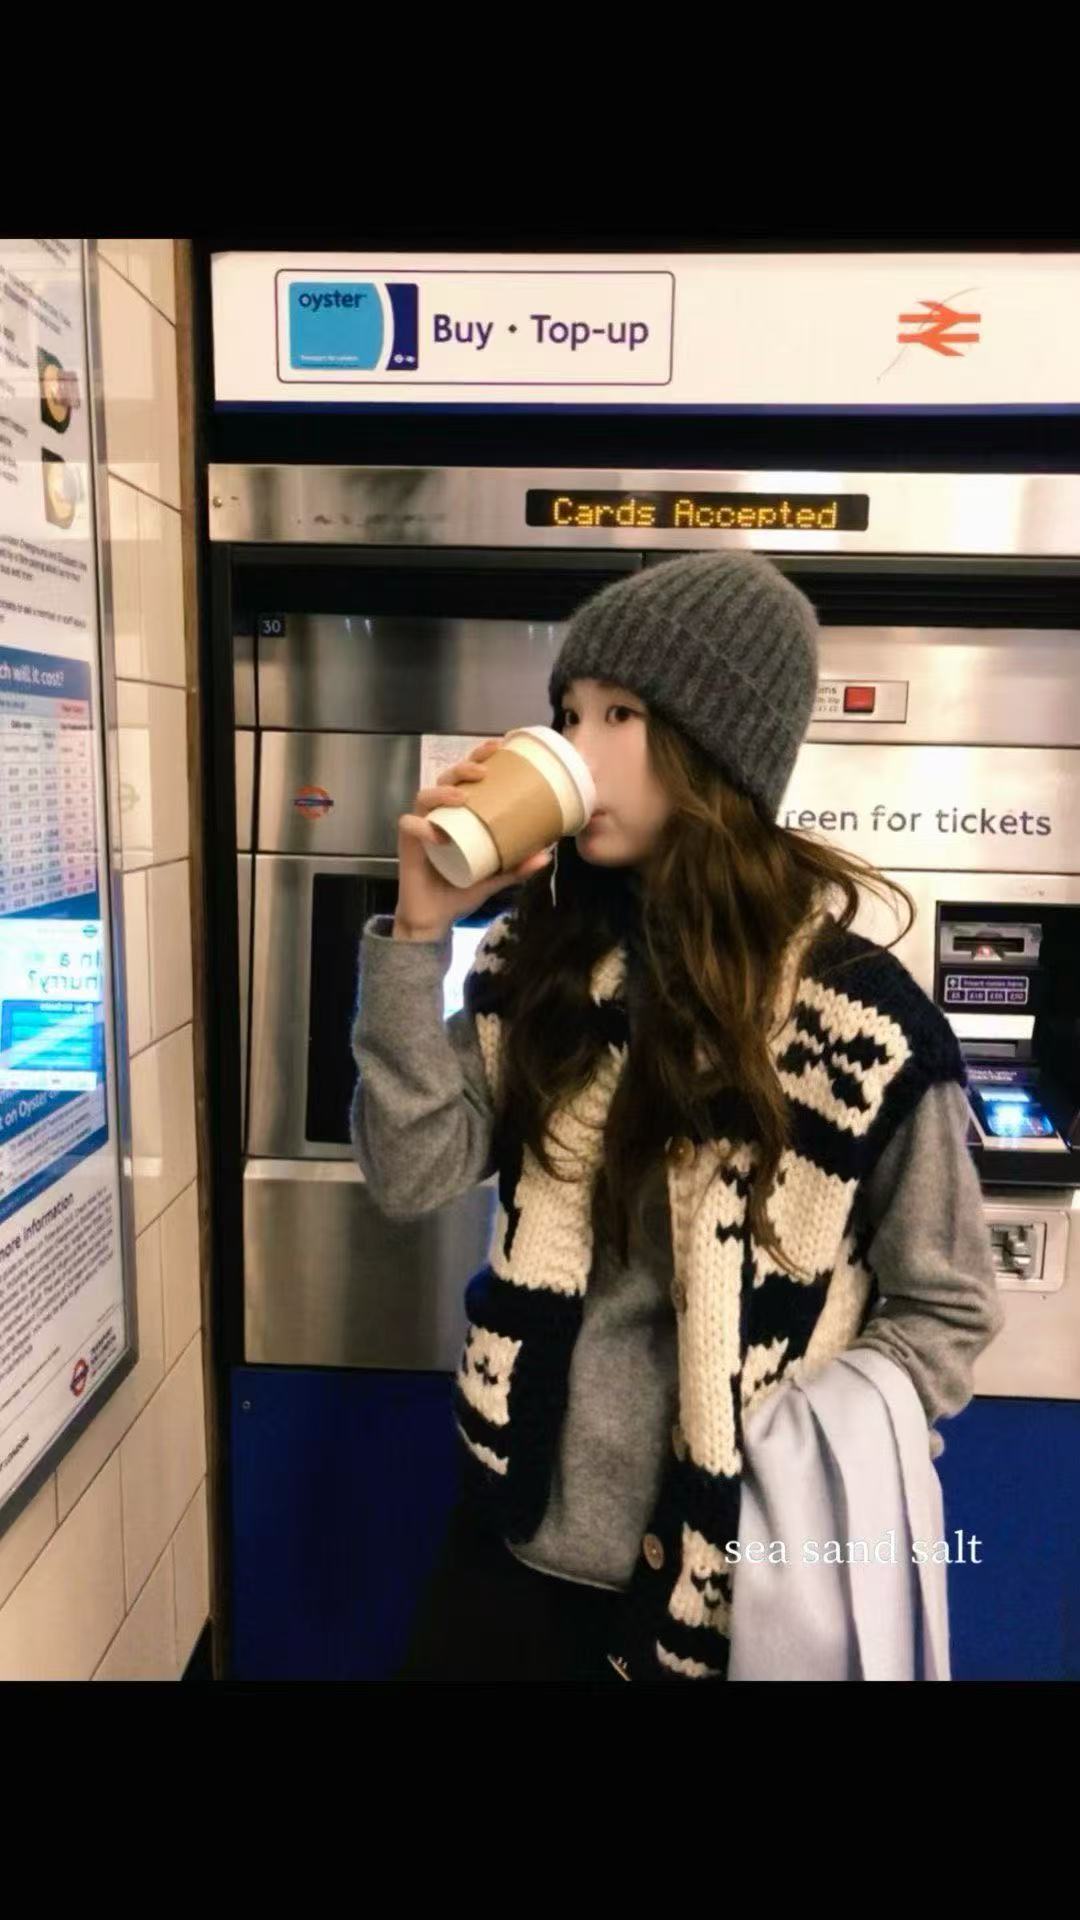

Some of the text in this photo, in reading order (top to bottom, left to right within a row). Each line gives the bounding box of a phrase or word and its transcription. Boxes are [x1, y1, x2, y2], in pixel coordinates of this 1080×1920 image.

[298, 289, 366, 312] oyster
[433, 314, 649, 351] Buy Top-up
[553, 498, 837, 528] Cards Accepted
[262, 621, 281, 633] 30
[785, 805, 1052, 836] reen for tickets
[23, 1193, 73, 1241] information
